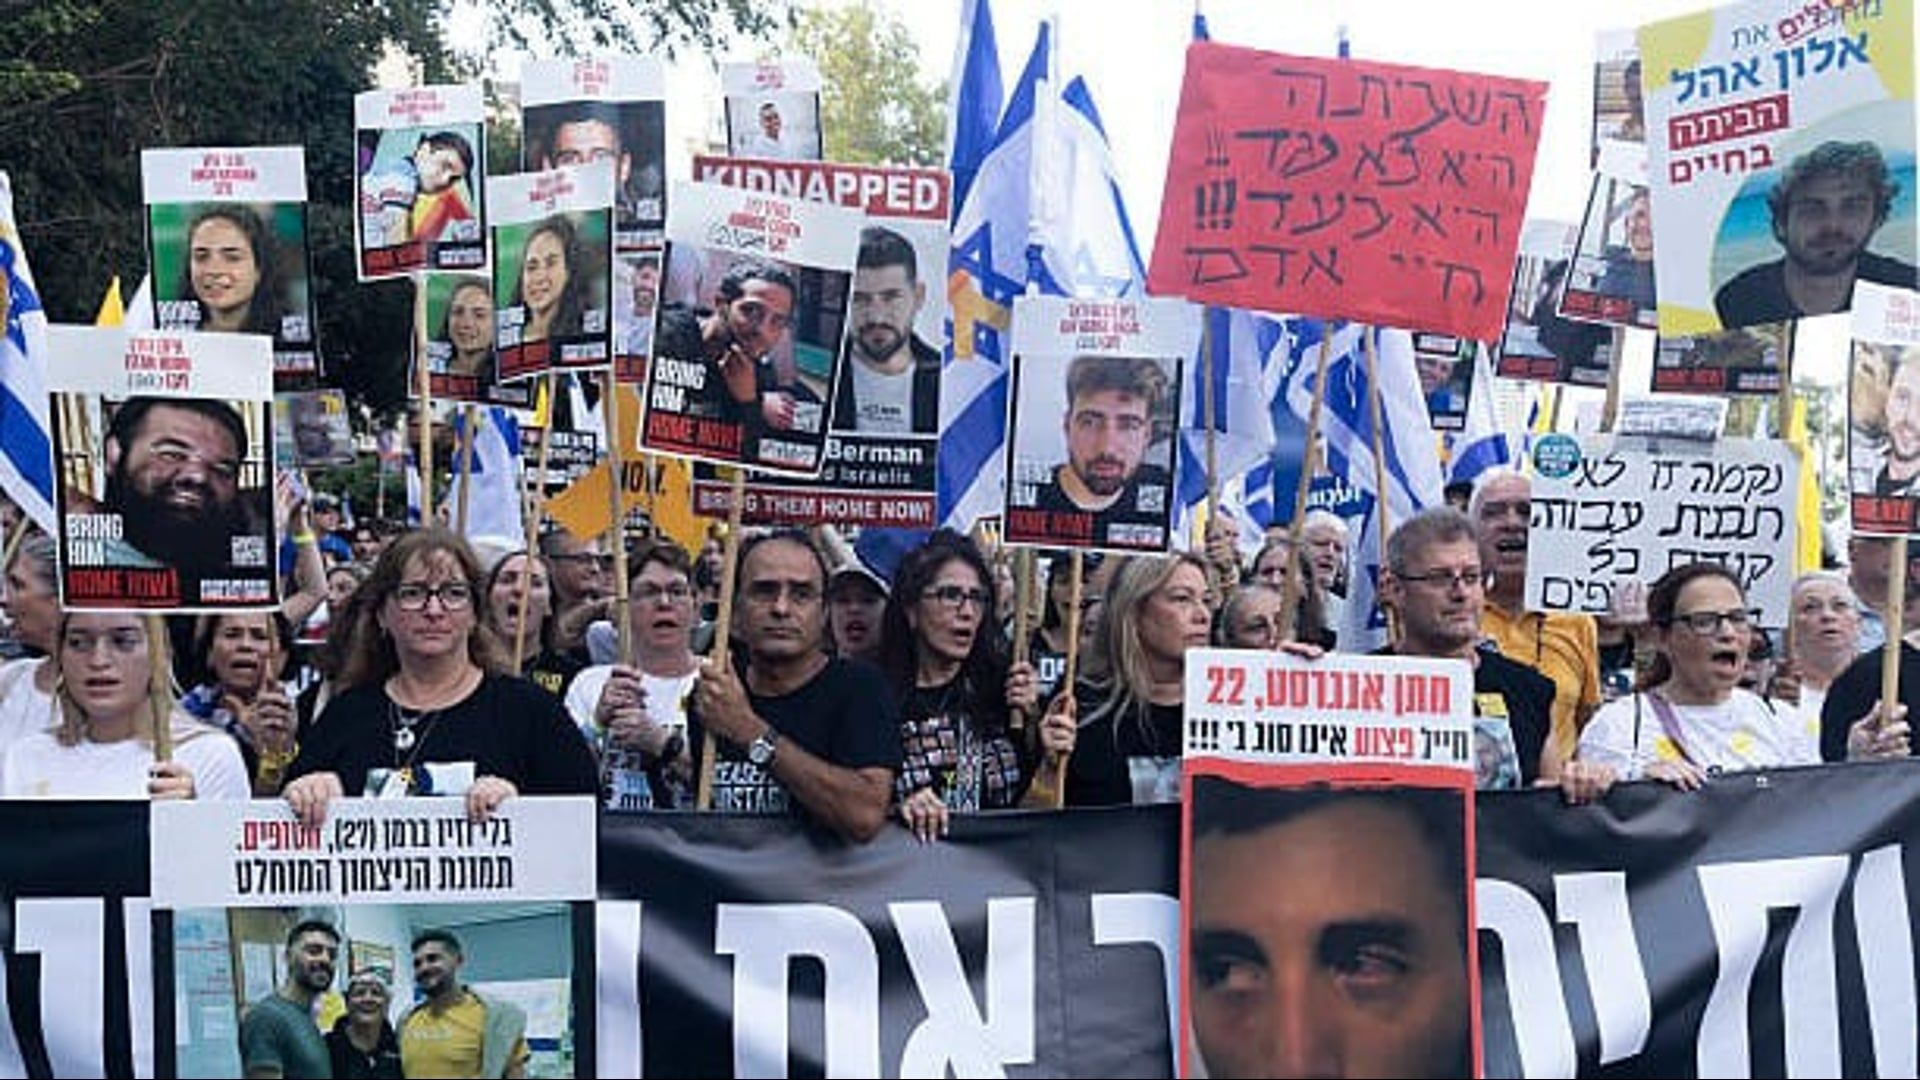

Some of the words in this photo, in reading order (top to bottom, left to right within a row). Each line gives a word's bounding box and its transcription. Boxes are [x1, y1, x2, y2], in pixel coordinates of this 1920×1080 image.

[1669, 56, 1763, 103] אהל
[1773, 32, 1870, 90] אלון
[1272, 67, 1530, 140] השביתה
[1673, 102, 1783, 147] הביתה
[1352, 136, 1422, 185] לא
[1439, 150, 1516, 188] היא
[1669, 144, 1774, 185] בחיים
[702, 164, 940, 212] KIDNAPPED
[1195, 179, 1237, 231] !!!
[1245, 190, 1394, 240] בעד
[1411, 203, 1500, 244] היא
[1184, 245, 1344, 287] אדם
[1388, 252, 1486, 308] חיי
[655, 356, 707, 391] BRING
[826, 439, 923, 464] Berman
[1573, 453, 1627, 488] לא
[841, 466, 912, 485] Israelis
[1652, 459, 1683, 491] זו
[1690, 461, 1783, 503] נקמה
[65, 513, 124, 541] BRING
[764, 496, 816, 516] THEM
[821, 497, 877, 518] HOME
[880, 501, 932, 521] NOW!
[1530, 498, 1644, 536] עבודה
[1657, 501, 1785, 542] תבנית
[68, 540, 104, 567] HIM
[1587, 535, 1642, 575] כל
[69, 568, 121, 598] HOME
[1206, 666, 1246, 706] 22
[1254, 667, 1385, 713] אנגרסט,
[1394, 673, 1451, 716] מתן
[1188, 718, 1220, 751] !!!
[1251, 721, 1294, 754] סוג
[1300, 722, 1347, 757] אינו
[1354, 726, 1414, 758] פצוע
[1420, 726, 1470, 761] חייל
[328, 816, 376, 854] (27),
[385, 818, 431, 852] ברמן
[235, 858, 333, 896] המוחלט
[338, 856, 431, 897] הניצחון
[437, 855, 513, 890] תמונת
